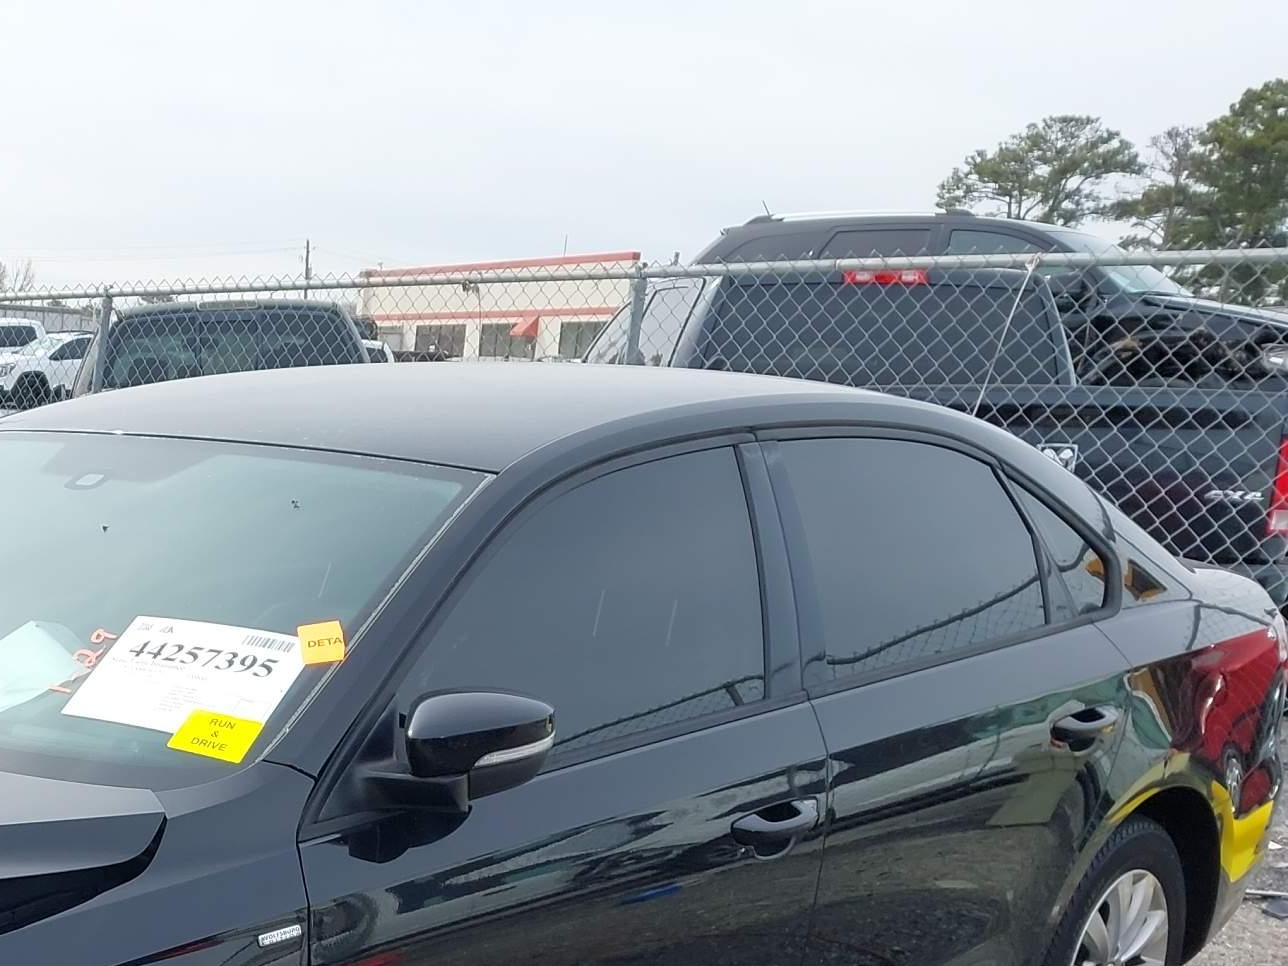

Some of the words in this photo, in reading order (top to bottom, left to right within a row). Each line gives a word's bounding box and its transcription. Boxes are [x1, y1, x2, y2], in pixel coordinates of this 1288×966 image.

[129, 640, 283, 678] 44257395
[209, 718, 237, 730] RUN
[210, 730, 220, 738] &
[190, 737, 229, 752] DRIVE
